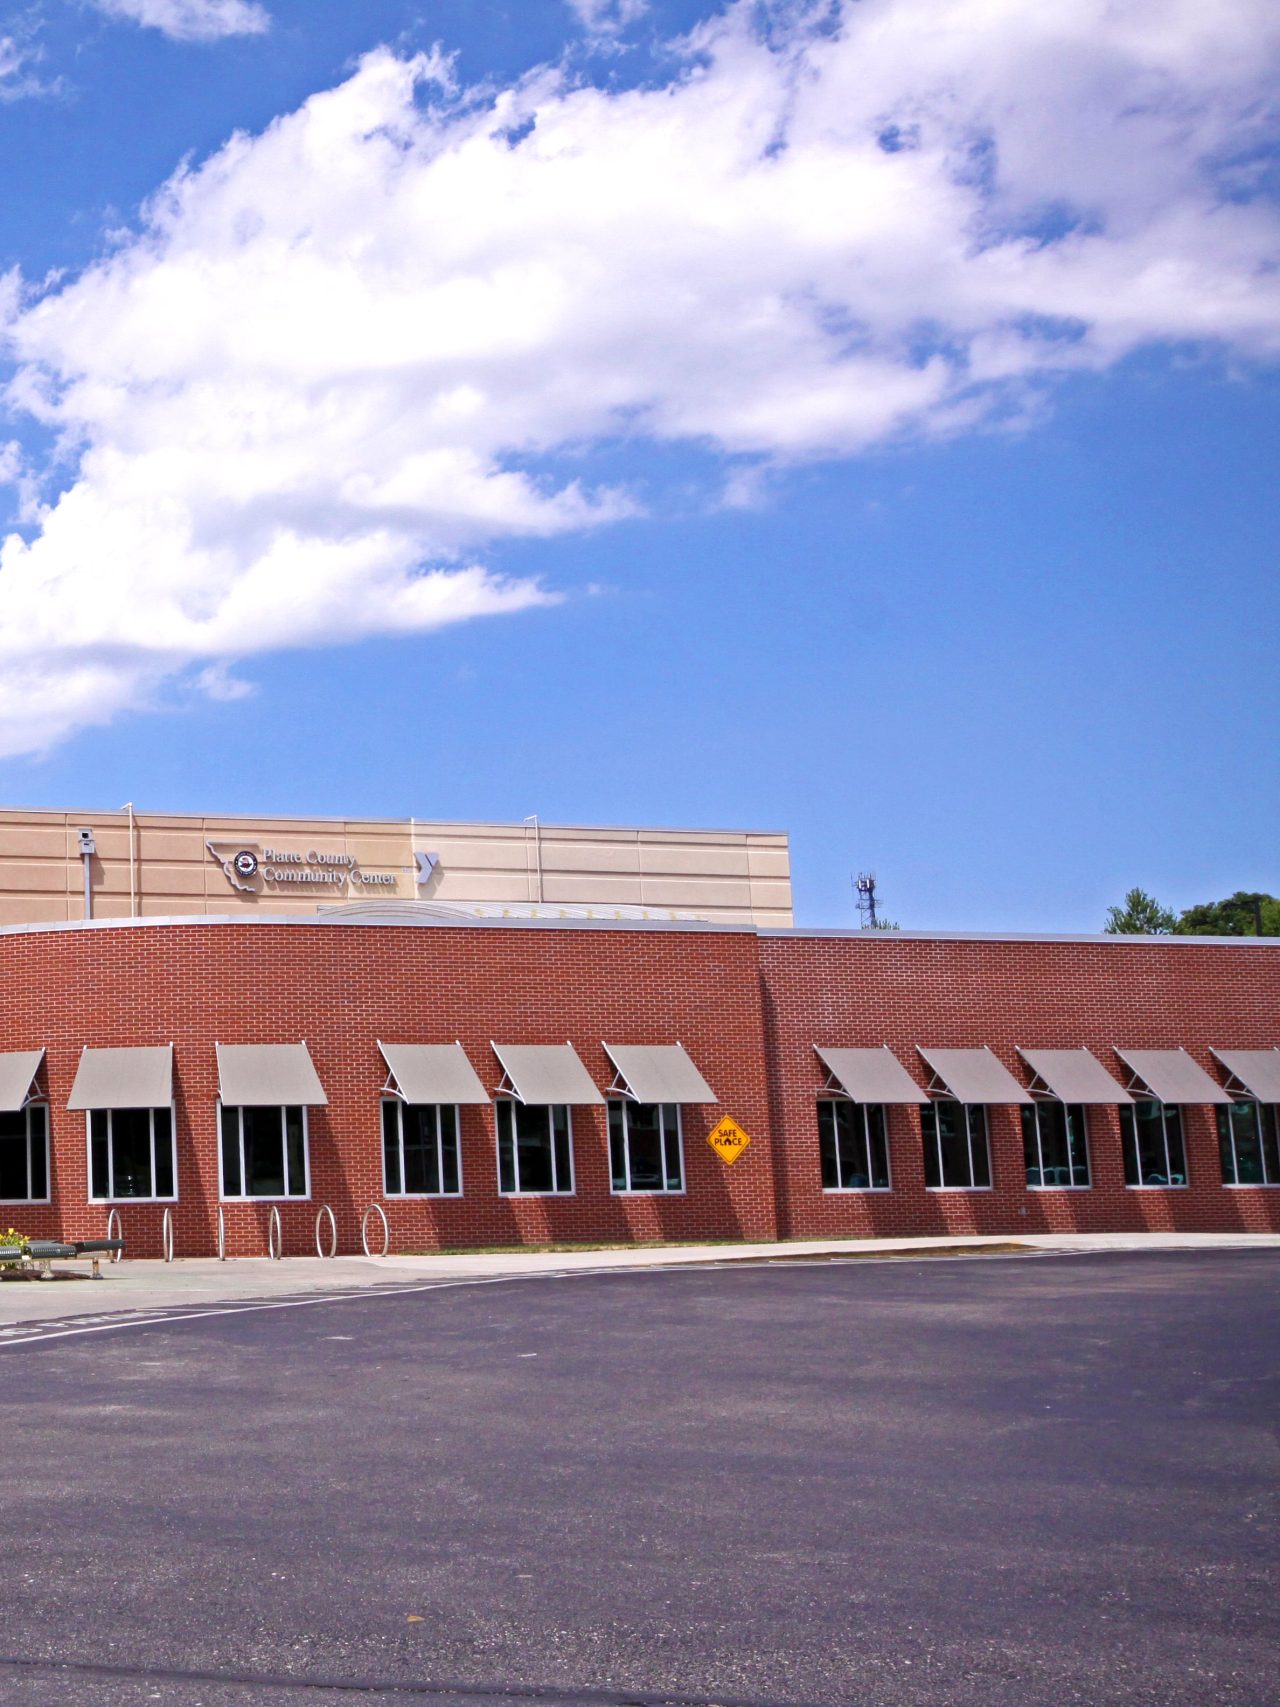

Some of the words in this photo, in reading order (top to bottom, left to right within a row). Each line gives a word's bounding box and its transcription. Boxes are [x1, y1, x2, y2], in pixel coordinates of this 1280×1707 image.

[263, 849, 302, 863] Platte
[305, 850, 355, 868] County
[263, 867, 347, 887] Community
[349, 870, 396, 884] Center
[718, 1129, 737, 1137] SAFE
